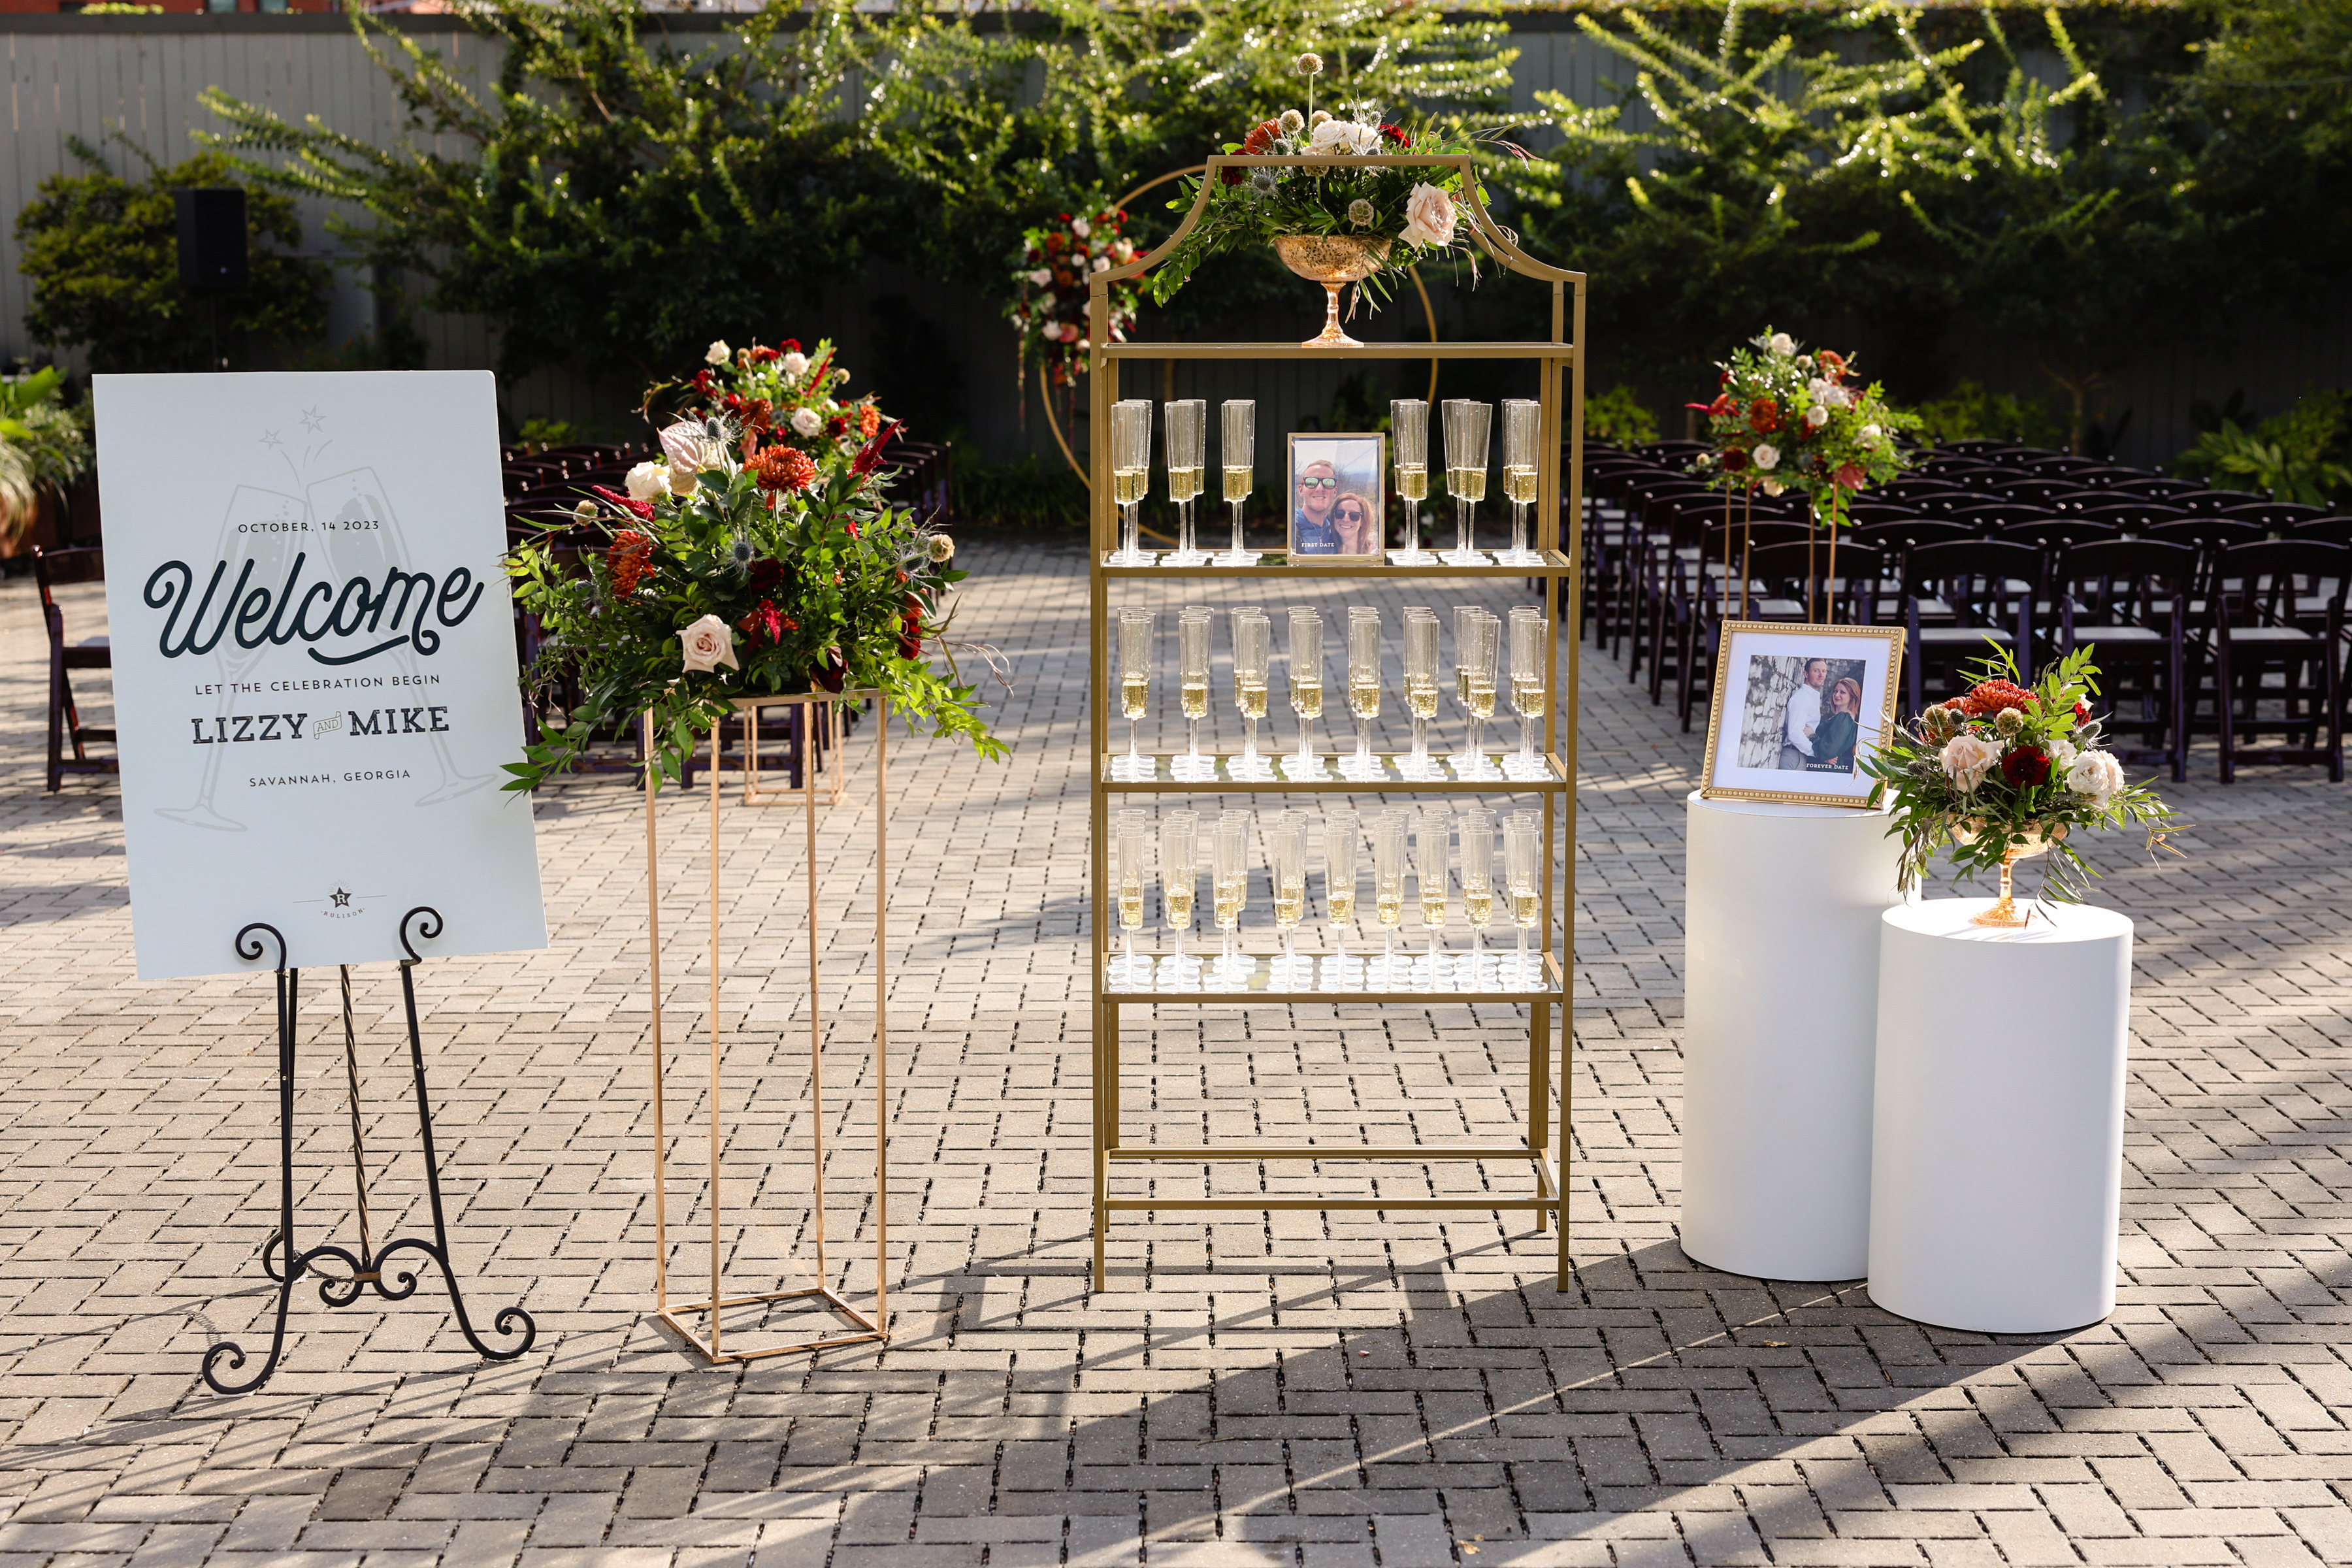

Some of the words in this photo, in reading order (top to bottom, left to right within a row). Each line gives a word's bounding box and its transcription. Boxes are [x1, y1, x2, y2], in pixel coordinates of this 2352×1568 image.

[238, 523, 314, 533] OCTOBER,
[321, 522, 336, 531] 14
[343, 521, 379, 531] 2023
[143, 551, 485, 666] Welcome
[195, 684, 223, 695] LET
[230, 683, 262, 693] THE
[270, 677, 383, 691] CELEBRATION
[392, 674, 440, 686] BEGIN
[191, 713, 308, 744] LIZZY
[317, 719, 338, 732] AND
[348, 706, 449, 736] MIKE
[250, 774, 336, 787] SAVANNAH,
[344, 770, 410, 781] GEORGIA
[336, 893, 347, 904] R
